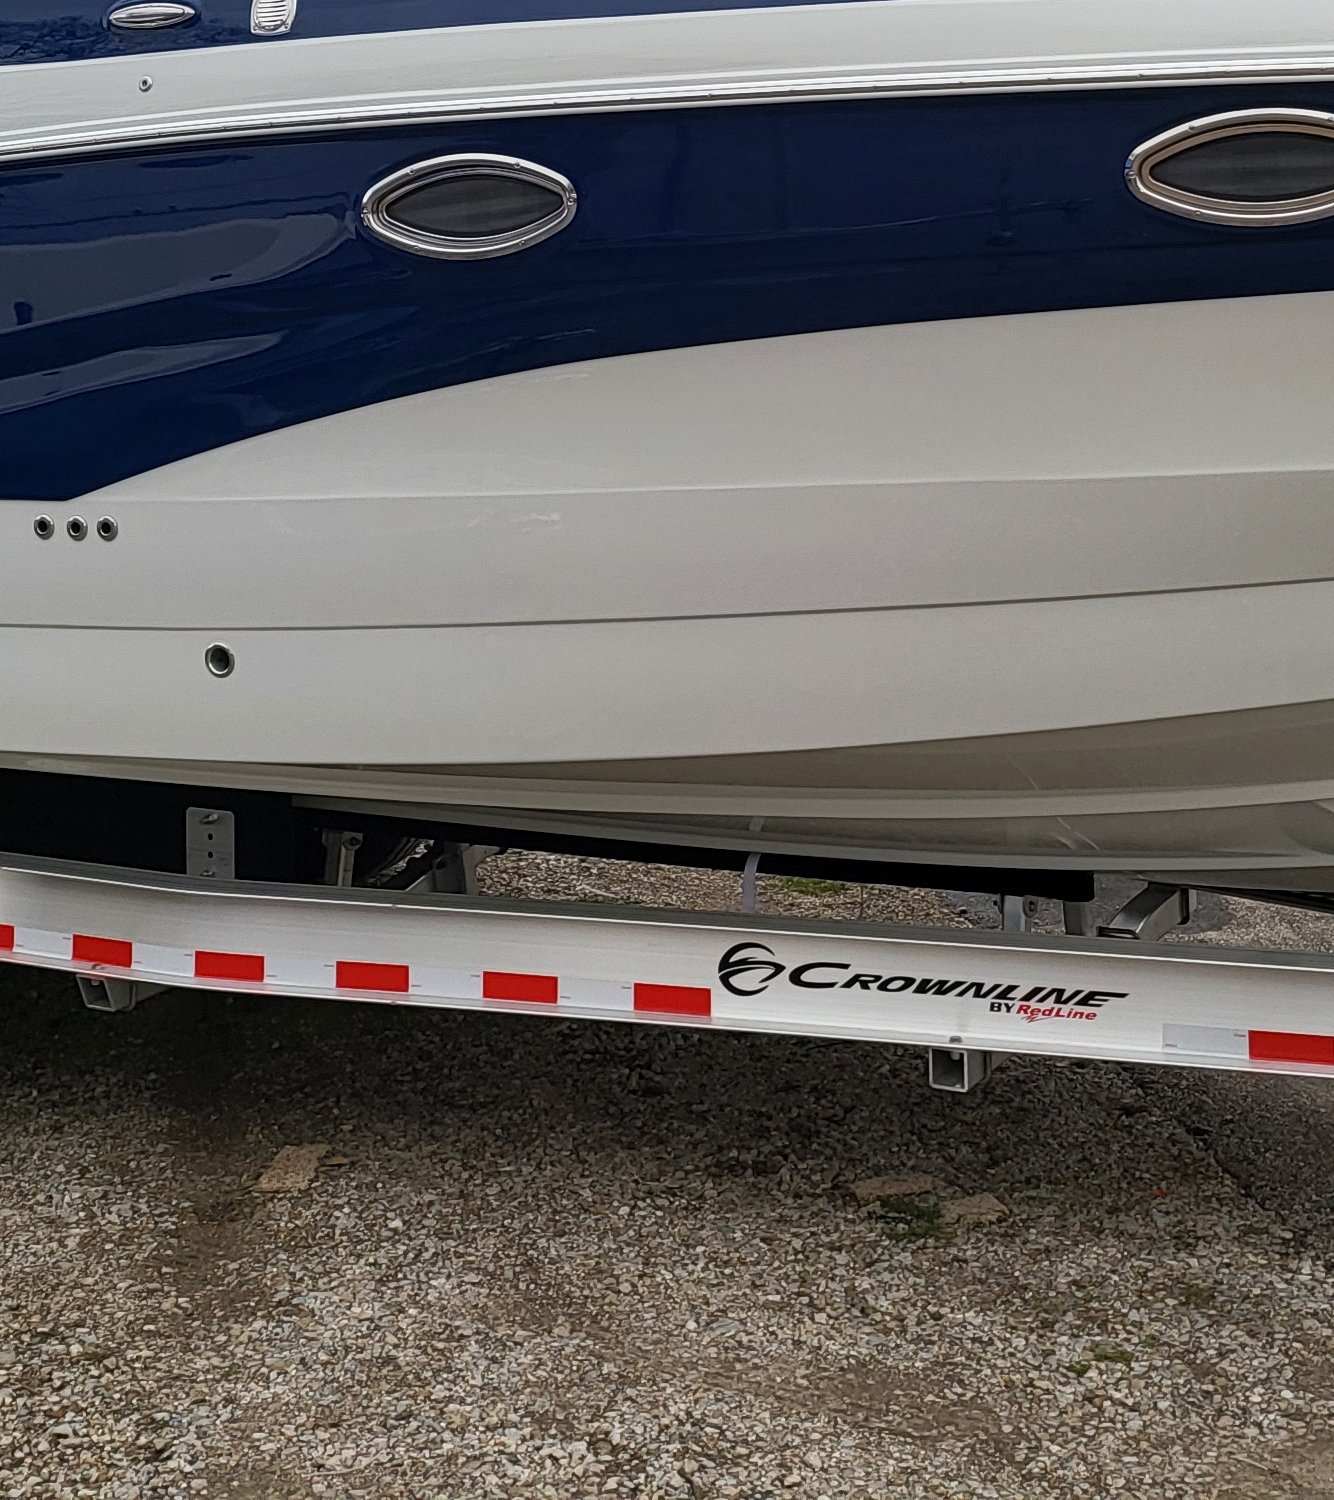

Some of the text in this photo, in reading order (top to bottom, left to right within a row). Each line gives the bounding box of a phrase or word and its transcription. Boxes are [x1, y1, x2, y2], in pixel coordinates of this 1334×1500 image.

[789, 962, 1129, 1007] CROWNLINE
[989, 1002, 1097, 1020] BY RedLine
